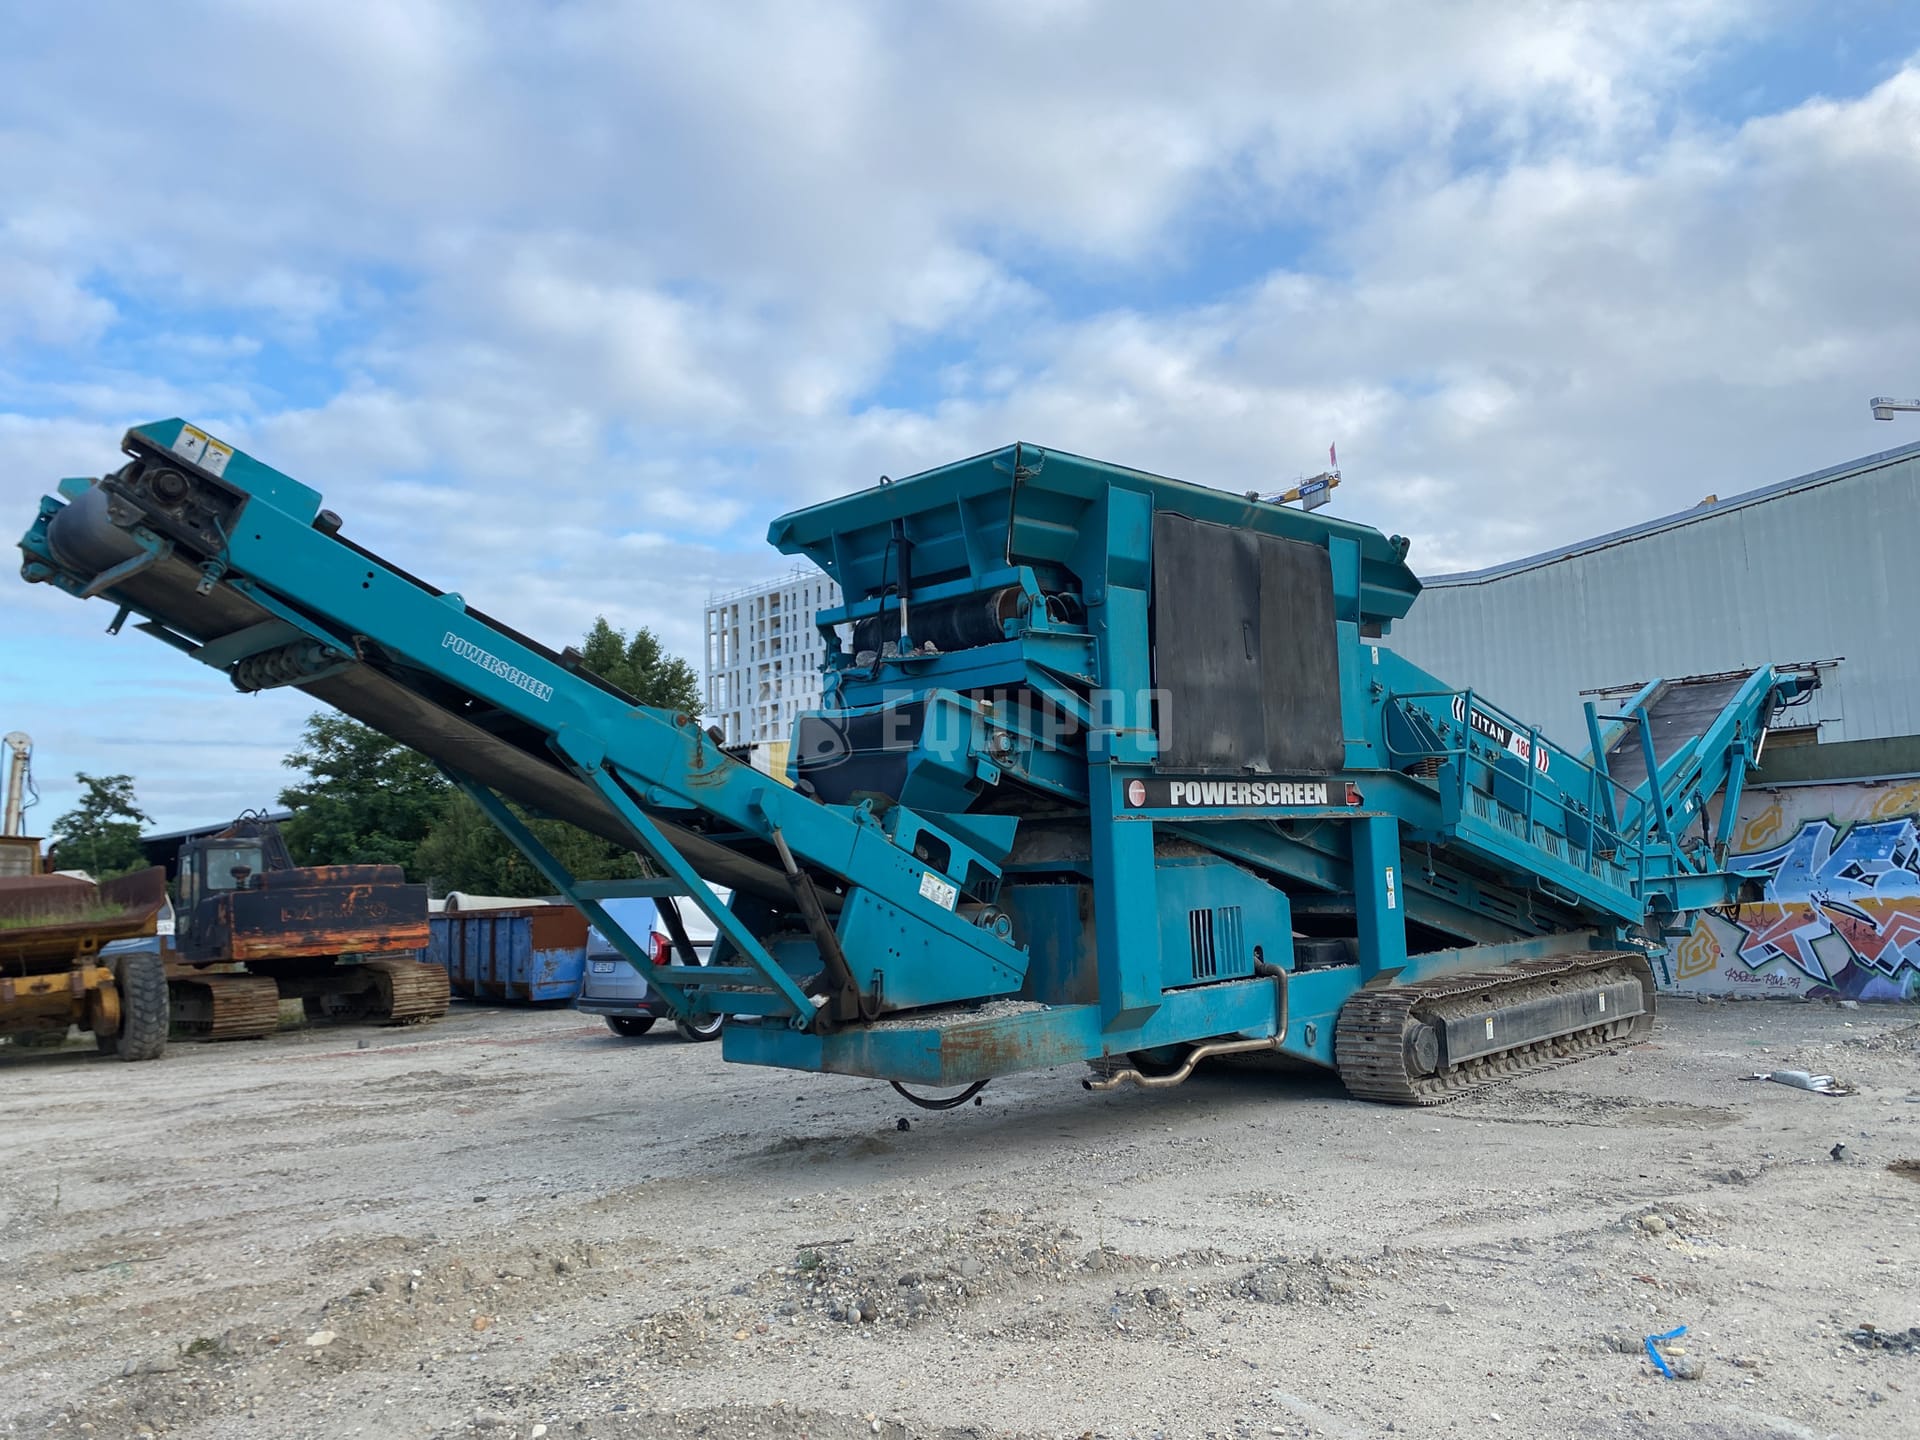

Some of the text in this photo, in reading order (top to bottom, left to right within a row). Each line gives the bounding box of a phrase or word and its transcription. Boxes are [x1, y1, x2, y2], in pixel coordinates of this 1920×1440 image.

[441, 631, 554, 702] POWERSCREEN
[1470, 710, 1530, 759] TITAN 180
[1169, 781, 1328, 806] POWERSCREEN
